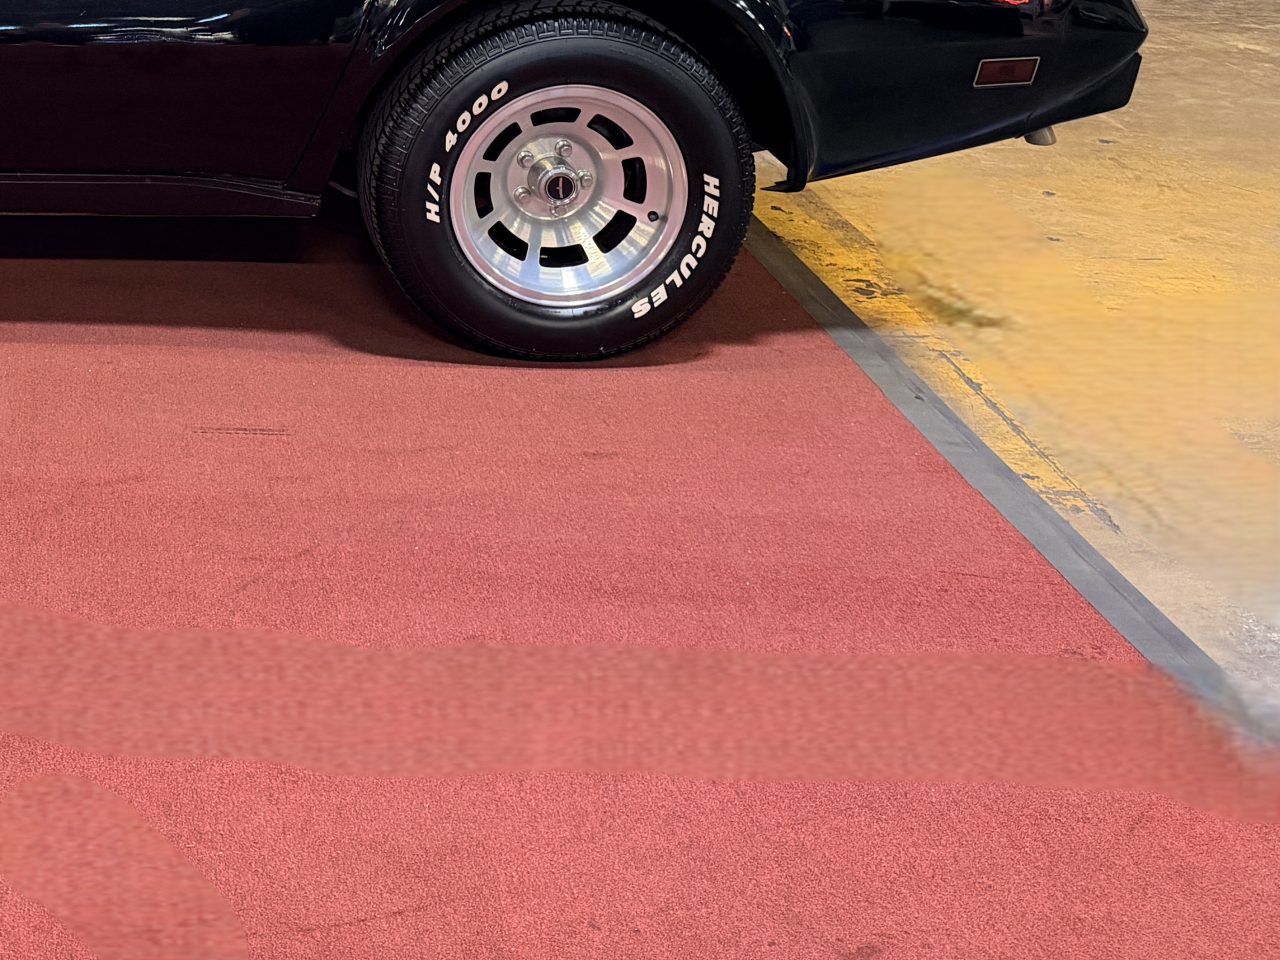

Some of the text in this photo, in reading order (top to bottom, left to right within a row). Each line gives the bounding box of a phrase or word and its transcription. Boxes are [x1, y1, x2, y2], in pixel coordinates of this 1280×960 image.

[425, 80, 509, 223] H/P 4000
[631, 173, 720, 319] HERCULES
